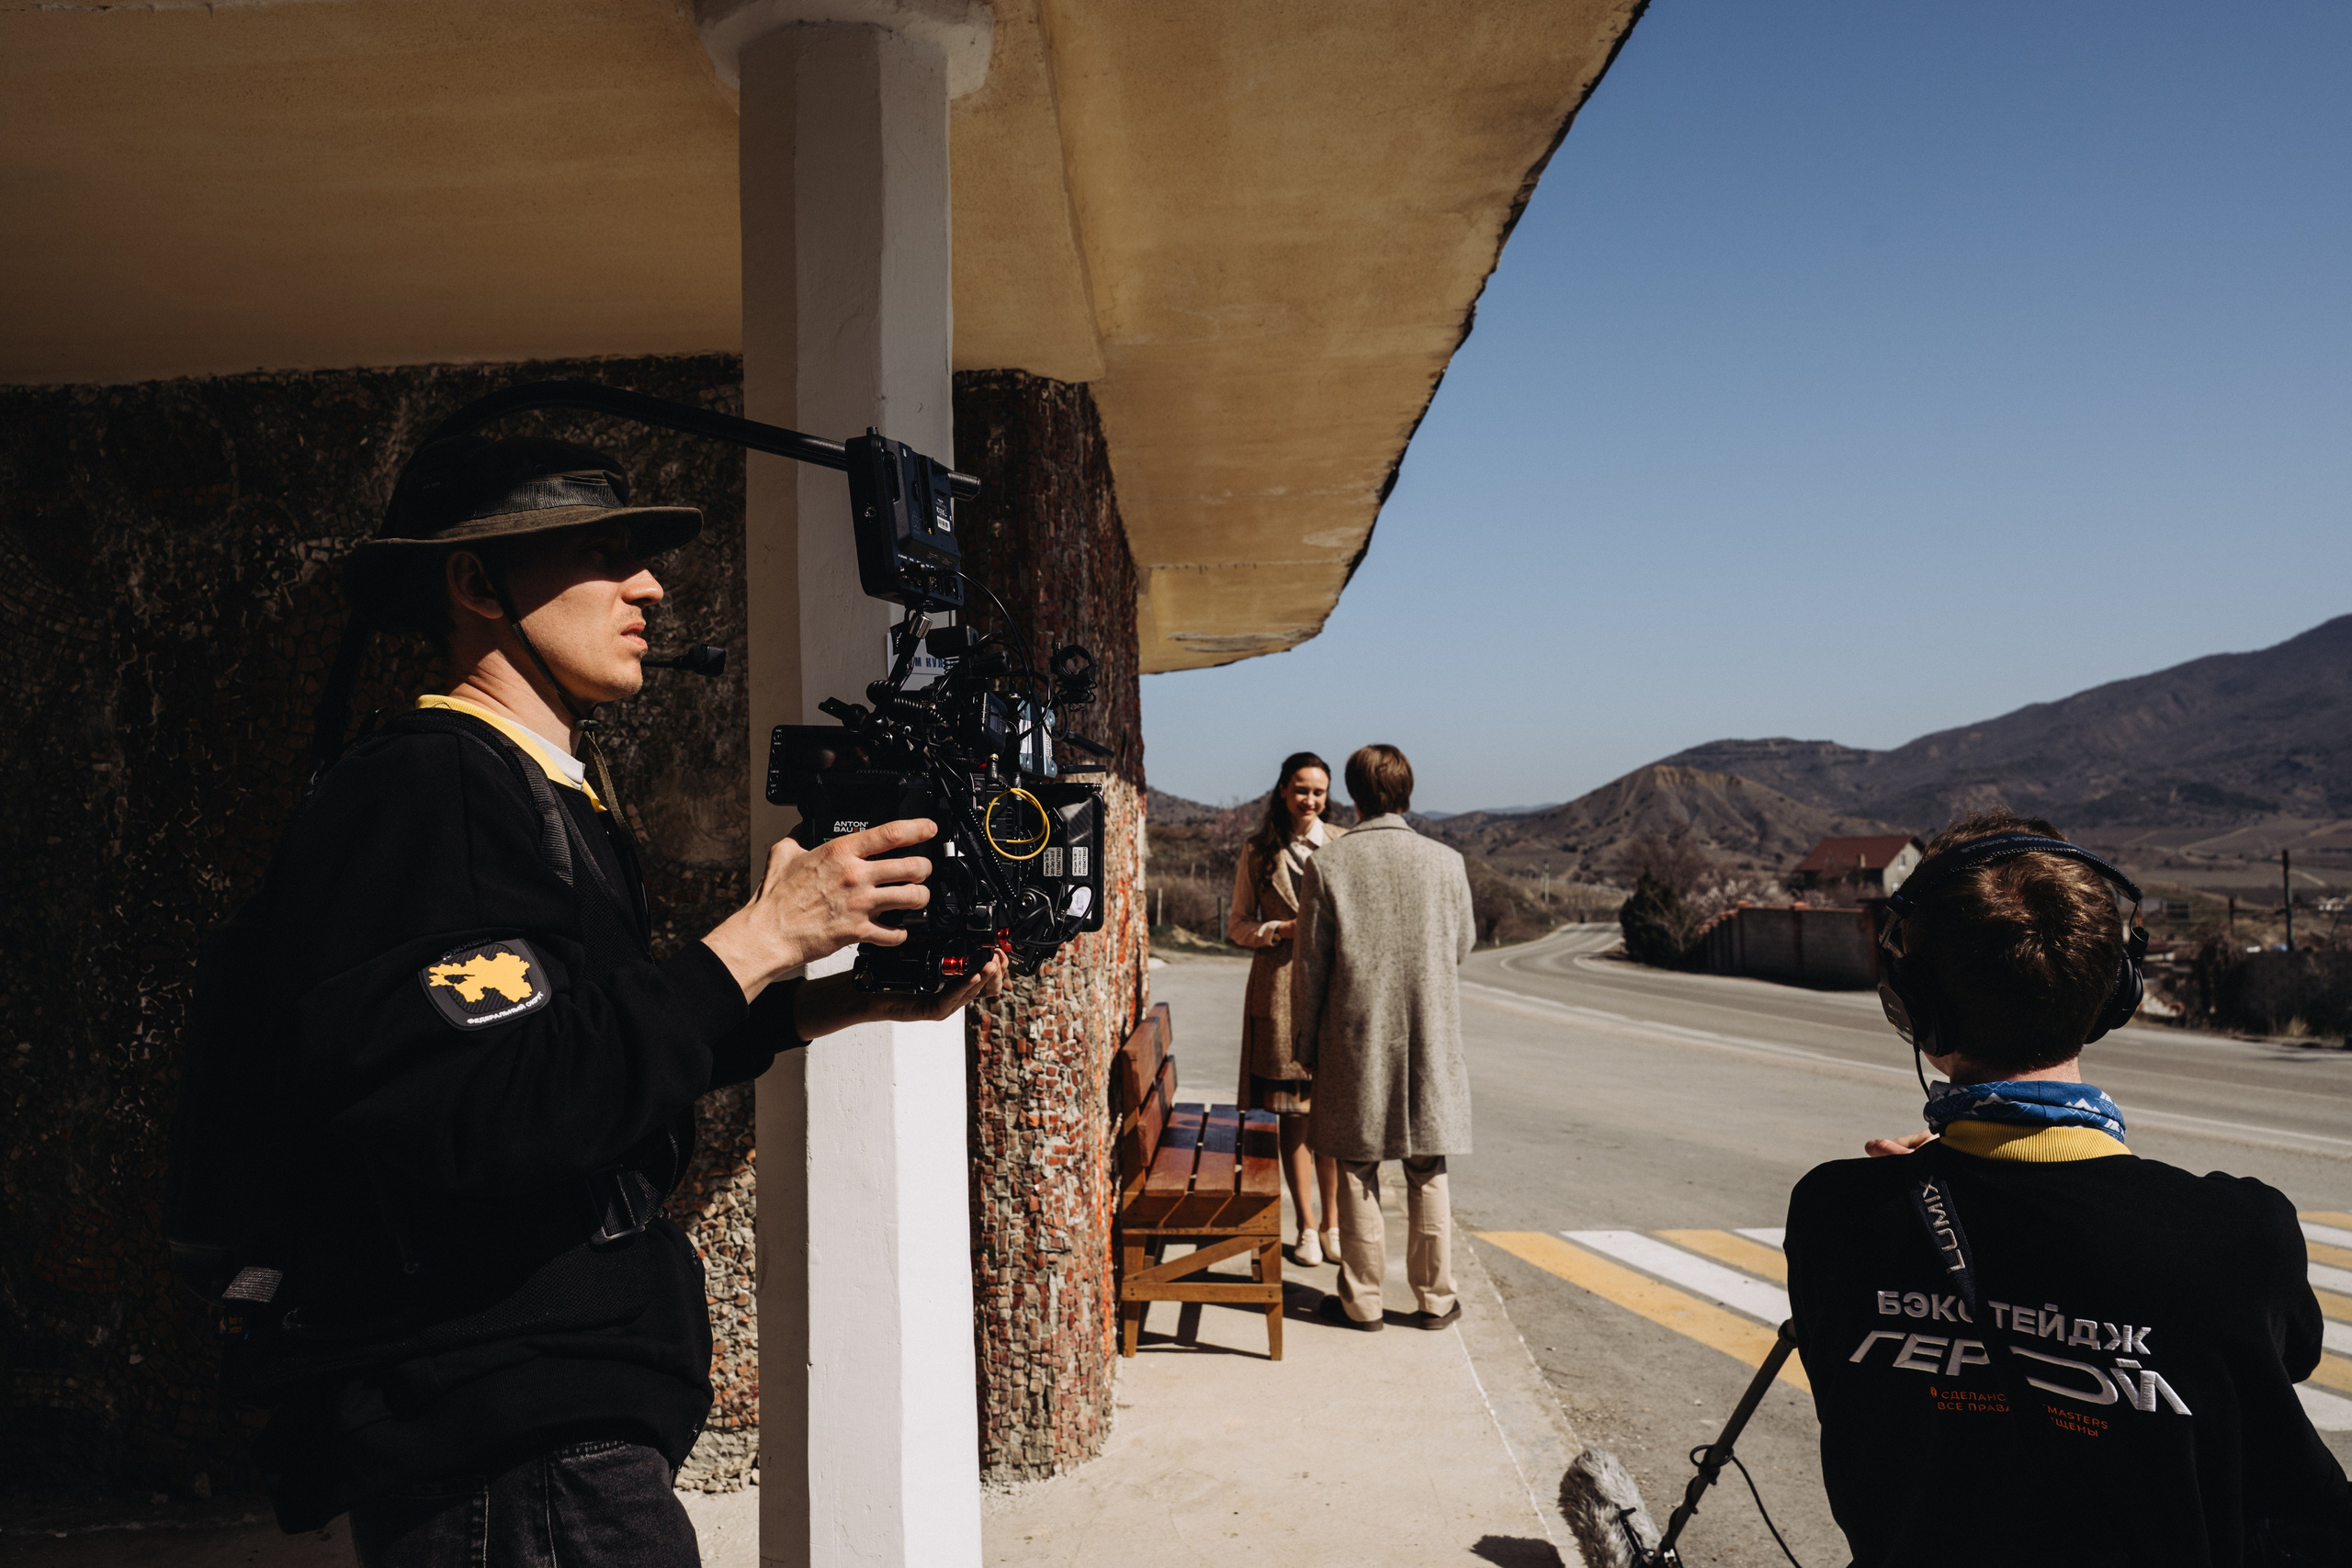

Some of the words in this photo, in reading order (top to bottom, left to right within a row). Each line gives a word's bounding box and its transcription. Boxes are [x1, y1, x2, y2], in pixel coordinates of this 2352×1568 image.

[1960, 838, 2008, 853] STUDIO
[467, 1003, 526, 1025] ФЕДЕРАЛЬНЫЙ
[525, 990, 544, 1008] ОКРУГ
[1918, 1175, 1966, 1275] LUMIX
[1937, 1402, 1963, 1411] ВСЕ
[2051, 1416, 2099, 1438] ЩЕНЫ
[2041, 1404, 2109, 1430] MASTERS
